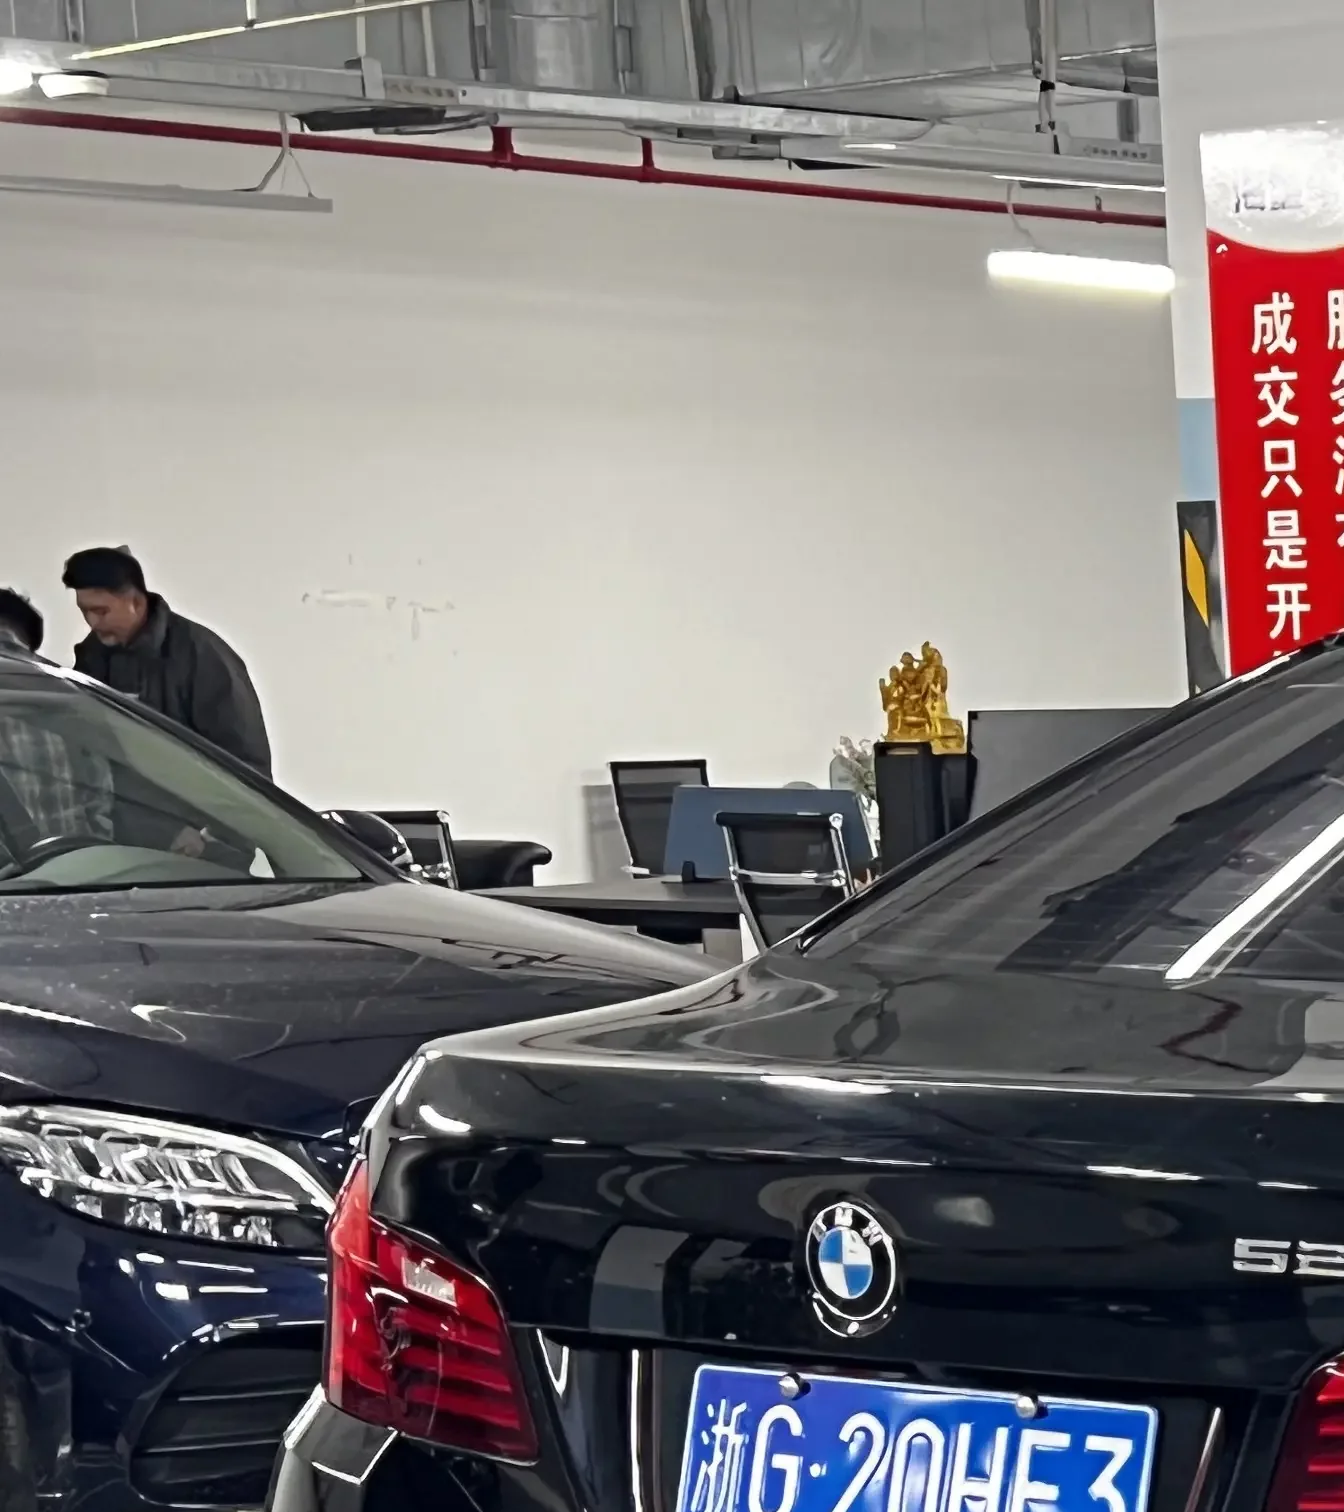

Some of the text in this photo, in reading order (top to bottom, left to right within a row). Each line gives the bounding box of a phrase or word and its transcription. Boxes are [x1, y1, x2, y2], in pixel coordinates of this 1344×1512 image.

[1251, 291, 1311, 657] 成交只是开
